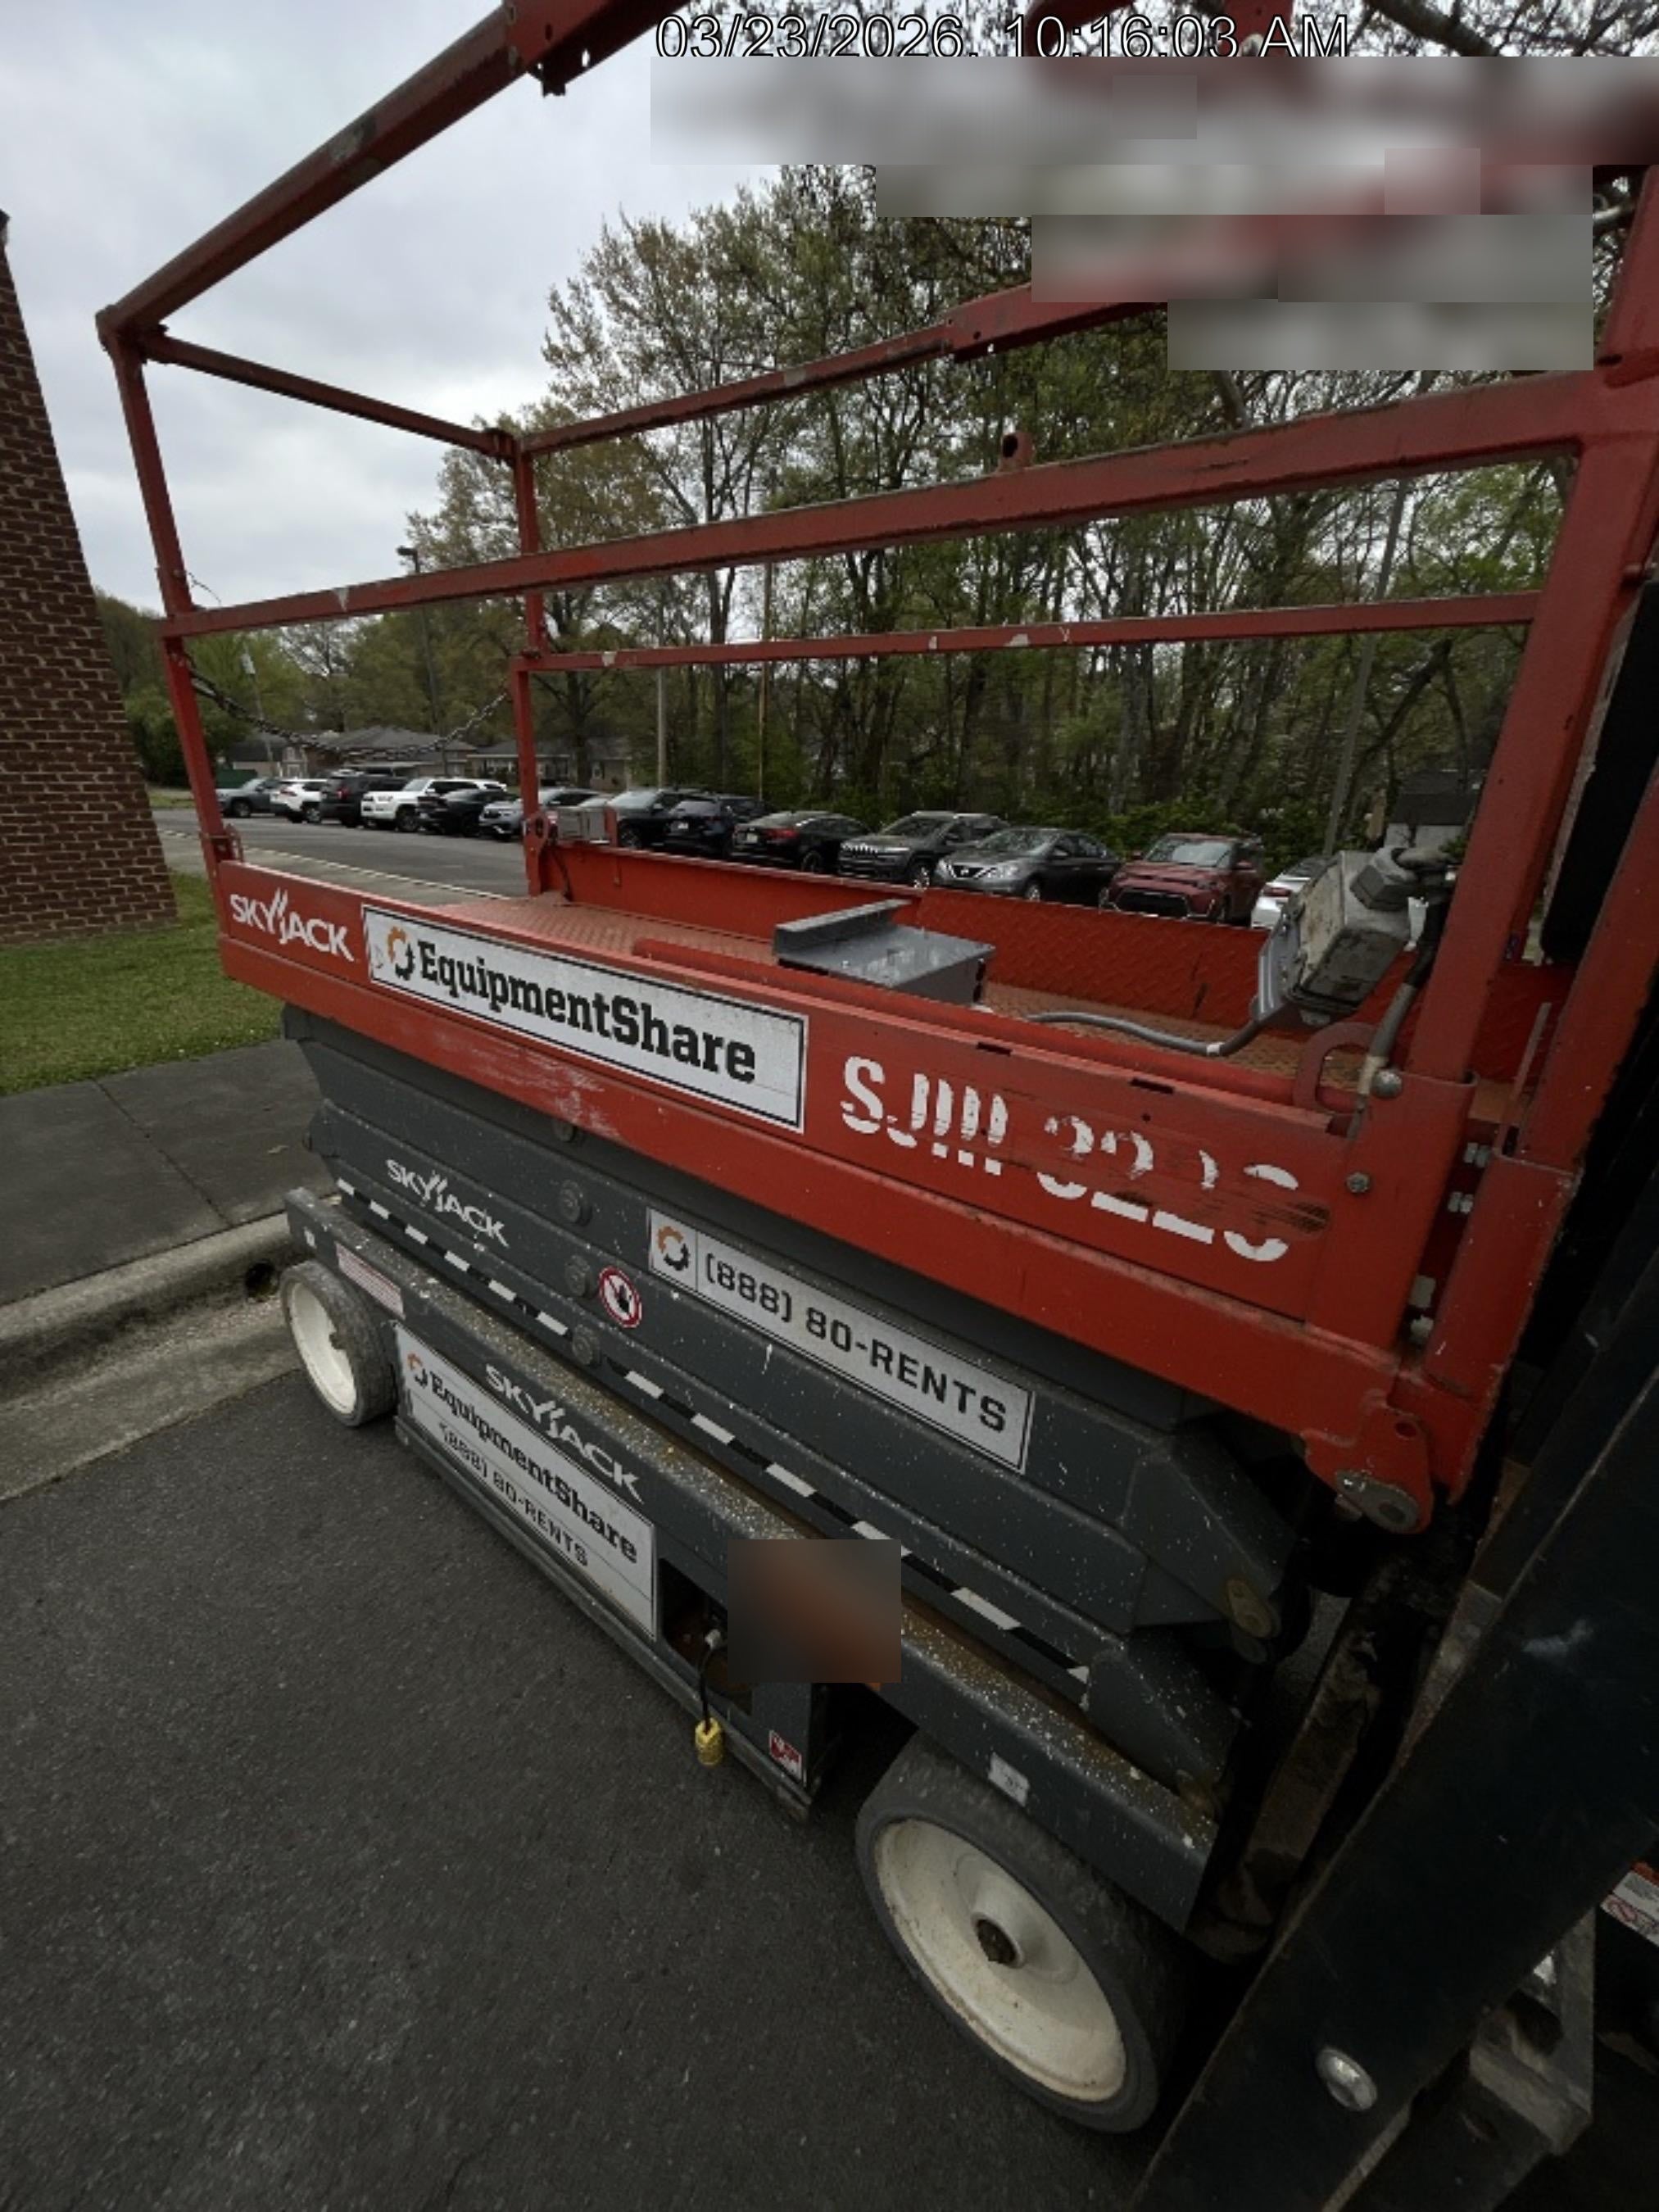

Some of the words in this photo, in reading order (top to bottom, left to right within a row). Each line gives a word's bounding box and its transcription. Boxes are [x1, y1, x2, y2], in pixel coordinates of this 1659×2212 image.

[230, 887, 355, 962] SKYJACK
[419, 940, 755, 1083] EquipmentShare
[386, 1158, 510, 1248] SKYJACK
[705, 1253, 792, 1322] (888)
[805, 1307, 1007, 1433] 80-RENTS
[428, 1370, 637, 1564] EquipmentShare
[486, 1363, 644, 1505] SKYJACK
[493, 1471, 588, 1566] 80-RENTS
